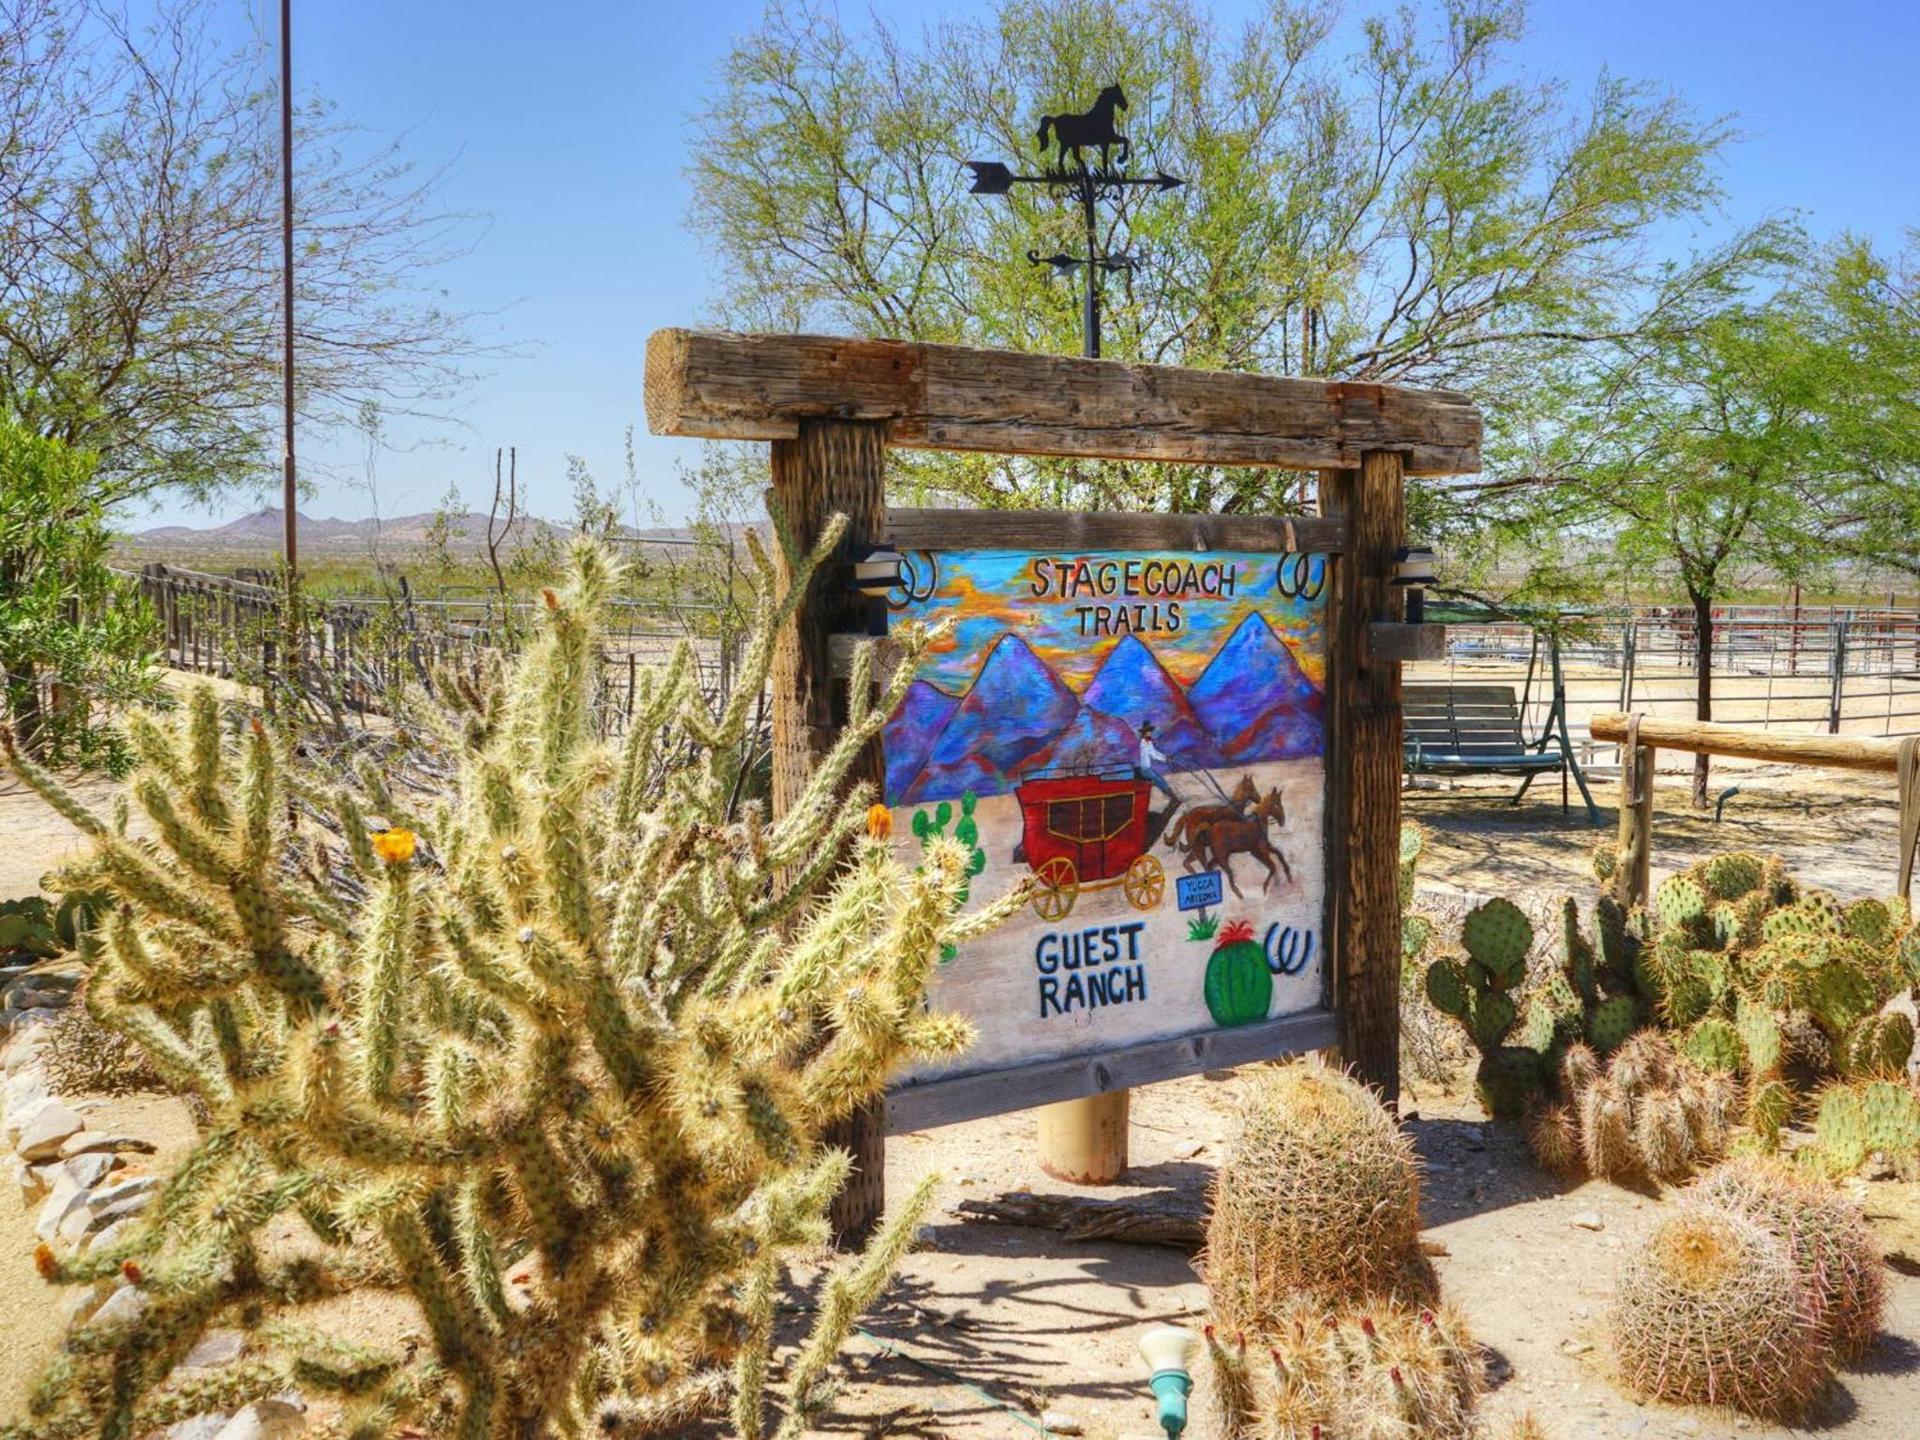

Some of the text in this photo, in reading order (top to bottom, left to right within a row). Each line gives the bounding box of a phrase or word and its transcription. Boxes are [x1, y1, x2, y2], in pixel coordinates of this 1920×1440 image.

[1031, 558, 1236, 598] STAGECOACH
[1075, 602, 1181, 636] TRAILS
[1036, 921, 1146, 974] GUEST
[1038, 963, 1147, 1018] RANCH
